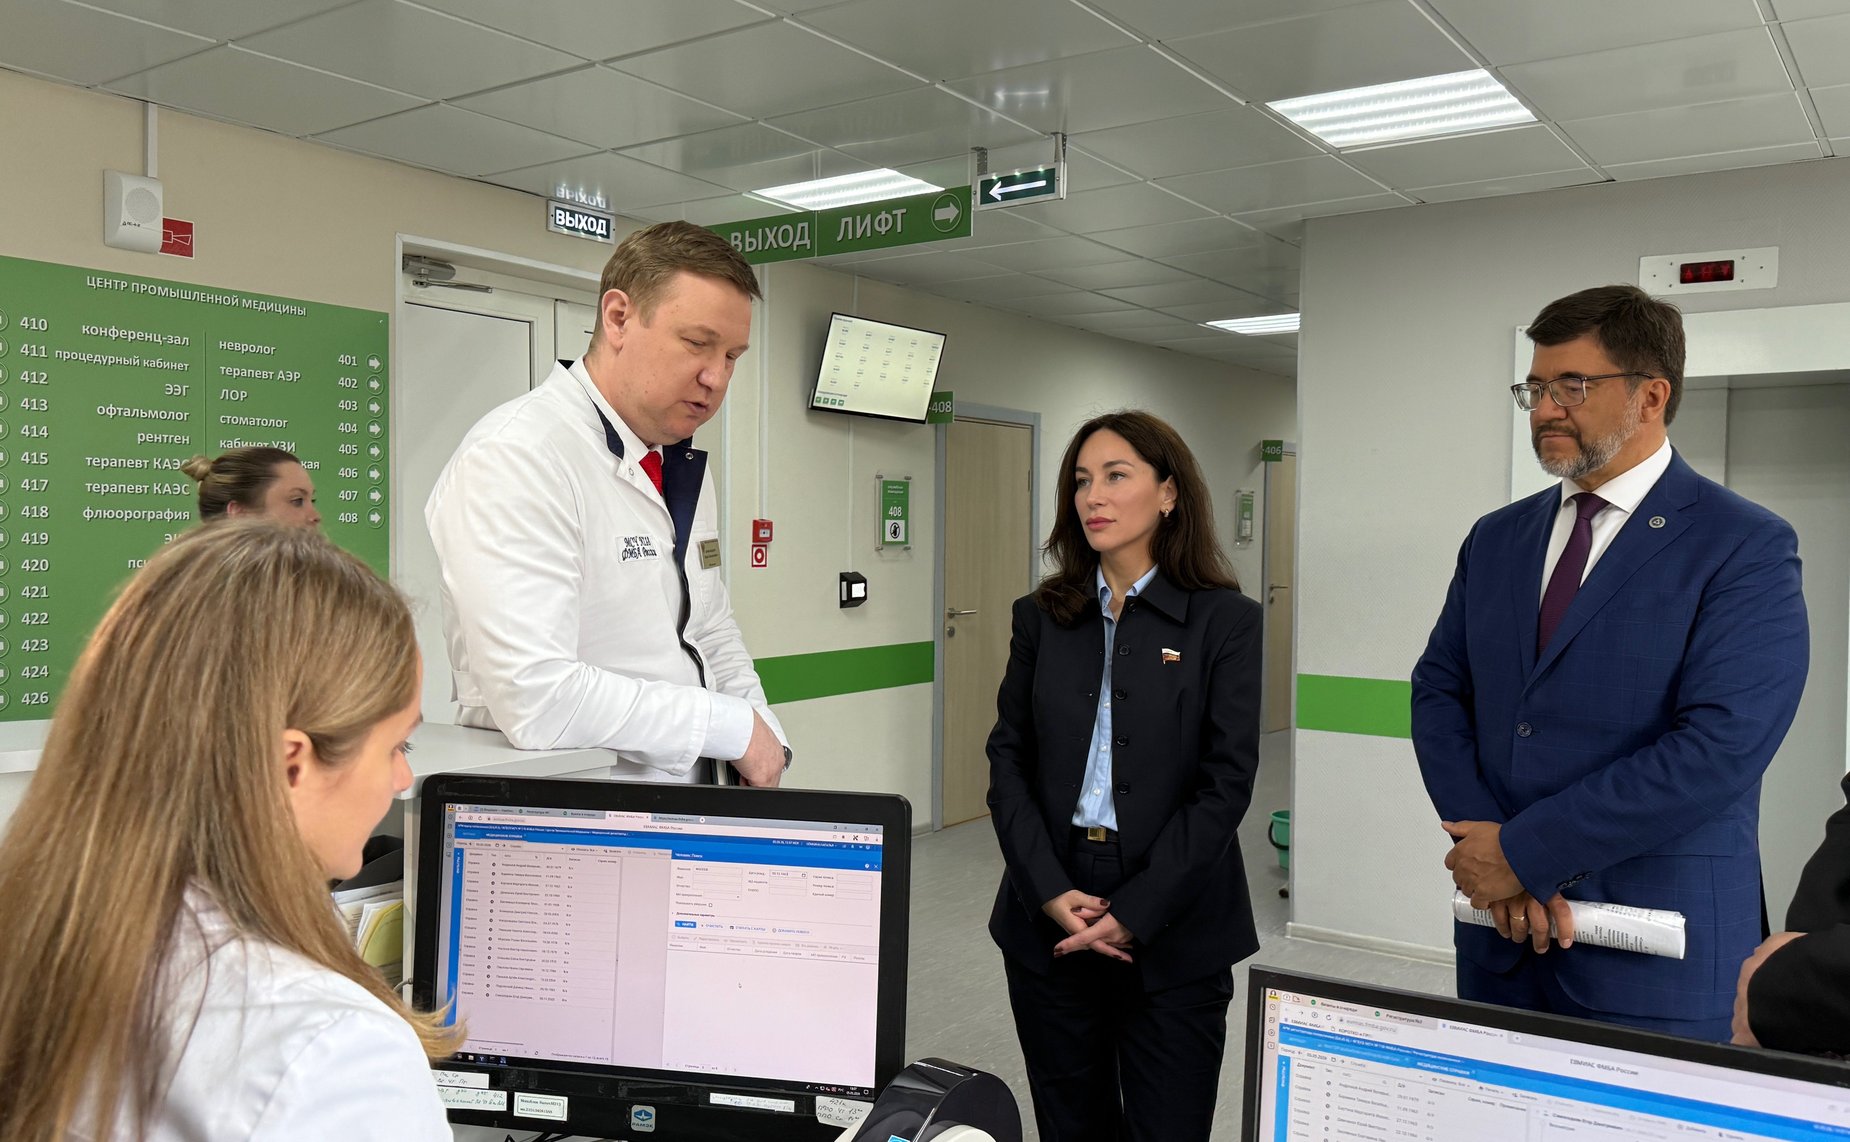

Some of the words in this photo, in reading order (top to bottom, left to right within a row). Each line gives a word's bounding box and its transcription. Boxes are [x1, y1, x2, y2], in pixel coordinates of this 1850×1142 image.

[555, 209, 607, 236] ВЫХОД
[836, 208, 907, 242] ЛИФТ
[730, 221, 811, 253] ВЫХОД
[86, 276, 129, 292] ЦЕНТР
[131, 281, 240, 307] ПРОМЫШЛЕННОЙ
[242, 298, 308, 317] МЕДИЦИНЫ
[20, 316, 48, 331] 410
[81, 324, 190, 346] конференц-зал
[20, 343, 48, 358] 411
[55, 350, 140, 367] процедурный
[143, 356, 190, 371] кабинет
[219, 340, 276, 355] невролог
[338, 354, 358, 366] 401
[20, 370, 49, 385] 412
[164, 383, 190, 397] ЭЭГ
[219, 366, 274, 382] терапевт
[277, 369, 301, 383] АЭР
[338, 377, 358, 389] 402
[219, 388, 248, 401] ЛОР
[338, 399, 358, 411] 403
[20, 397, 48, 412] 413
[96, 403, 190, 421] офтальмолог
[219, 415, 288, 428] стоматолог
[338, 422, 358, 434] 404
[20, 424, 49, 438] 414
[137, 432, 190, 446] рентген
[272, 440, 296, 453] УЗИ
[338, 443, 358, 455] 405
[20, 451, 48, 465] 415
[85, 456, 149, 470] терапевт
[153, 457, 188, 470] КАЭ
[338, 467, 358, 478] 406
[20, 478, 49, 492] 417
[85, 482, 149, 496] терапевт
[153, 482, 190, 496] КАЭС
[338, 489, 358, 501] 407
[20, 505, 49, 519] 418
[82, 505, 190, 523] флюорография
[338, 512, 358, 523] 408
[888, 506, 902, 517] 408
[21, 532, 49, 545] 419
[21, 558, 49, 572] 420
[21, 585, 49, 598] 421
[21, 612, 49, 625] 422
[21, 638, 49, 652] 423
[21, 665, 49, 679] 424
[22, 691, 49, 705] 426
